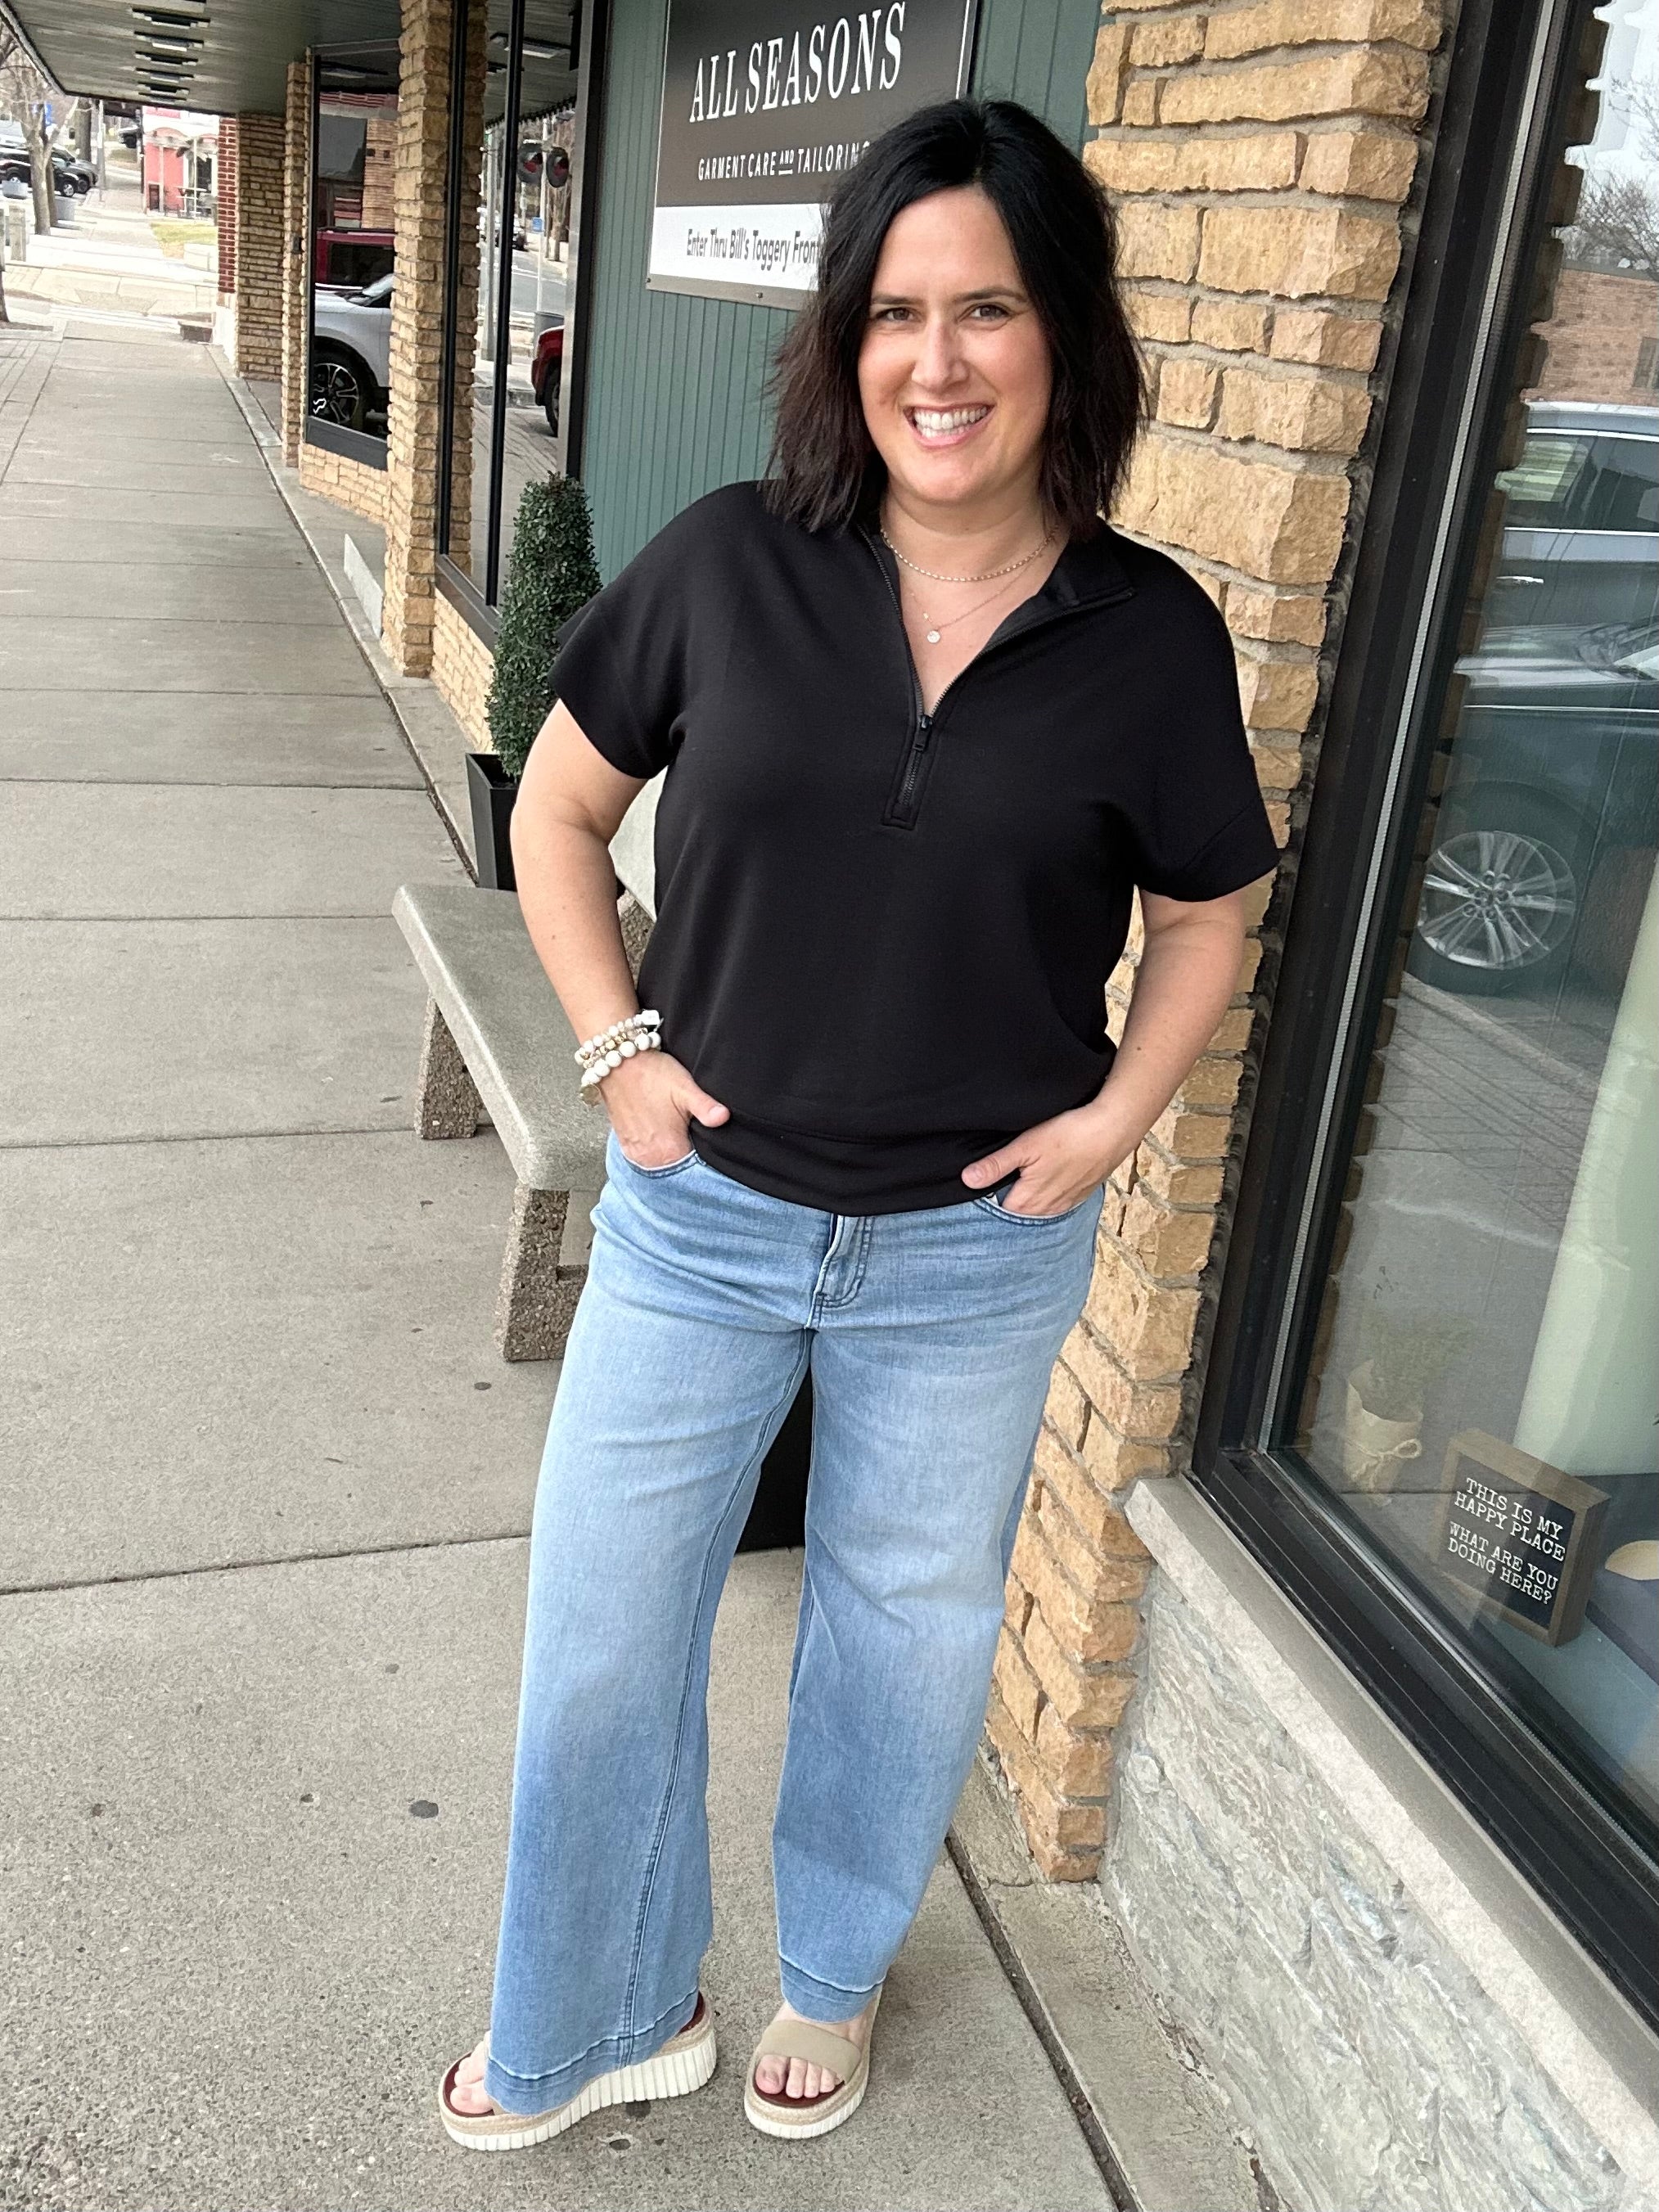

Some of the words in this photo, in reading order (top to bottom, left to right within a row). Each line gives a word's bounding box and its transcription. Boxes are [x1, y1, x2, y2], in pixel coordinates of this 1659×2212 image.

[689, 51, 738, 123] ALL
[745, 1, 905, 114] SEASONS
[697, 155, 746, 181] GARMENT
[747, 151, 777, 178] CARE
[687, 228, 708, 258] Enter
[710, 227, 728, 259] Thru
[729, 227, 750, 260] Bill's
[752, 229, 791, 273] Toggery
[1454, 1490, 1508, 1529] HAPPY
[1510, 1520, 1566, 1563] PLACE
[1466, 1477, 1508, 1511] THIS
[1511, 1502, 1533, 1525] IS
[1537, 1516, 1563, 1541] MY
[1448, 1538, 1496, 1575] DOING
[1499, 1566, 1553, 1605] HERE?
[1449, 1520, 1490, 1552] WHAT
[1491, 1546, 1523, 1572] ARE
[1527, 1563, 1558, 1591] YOU
